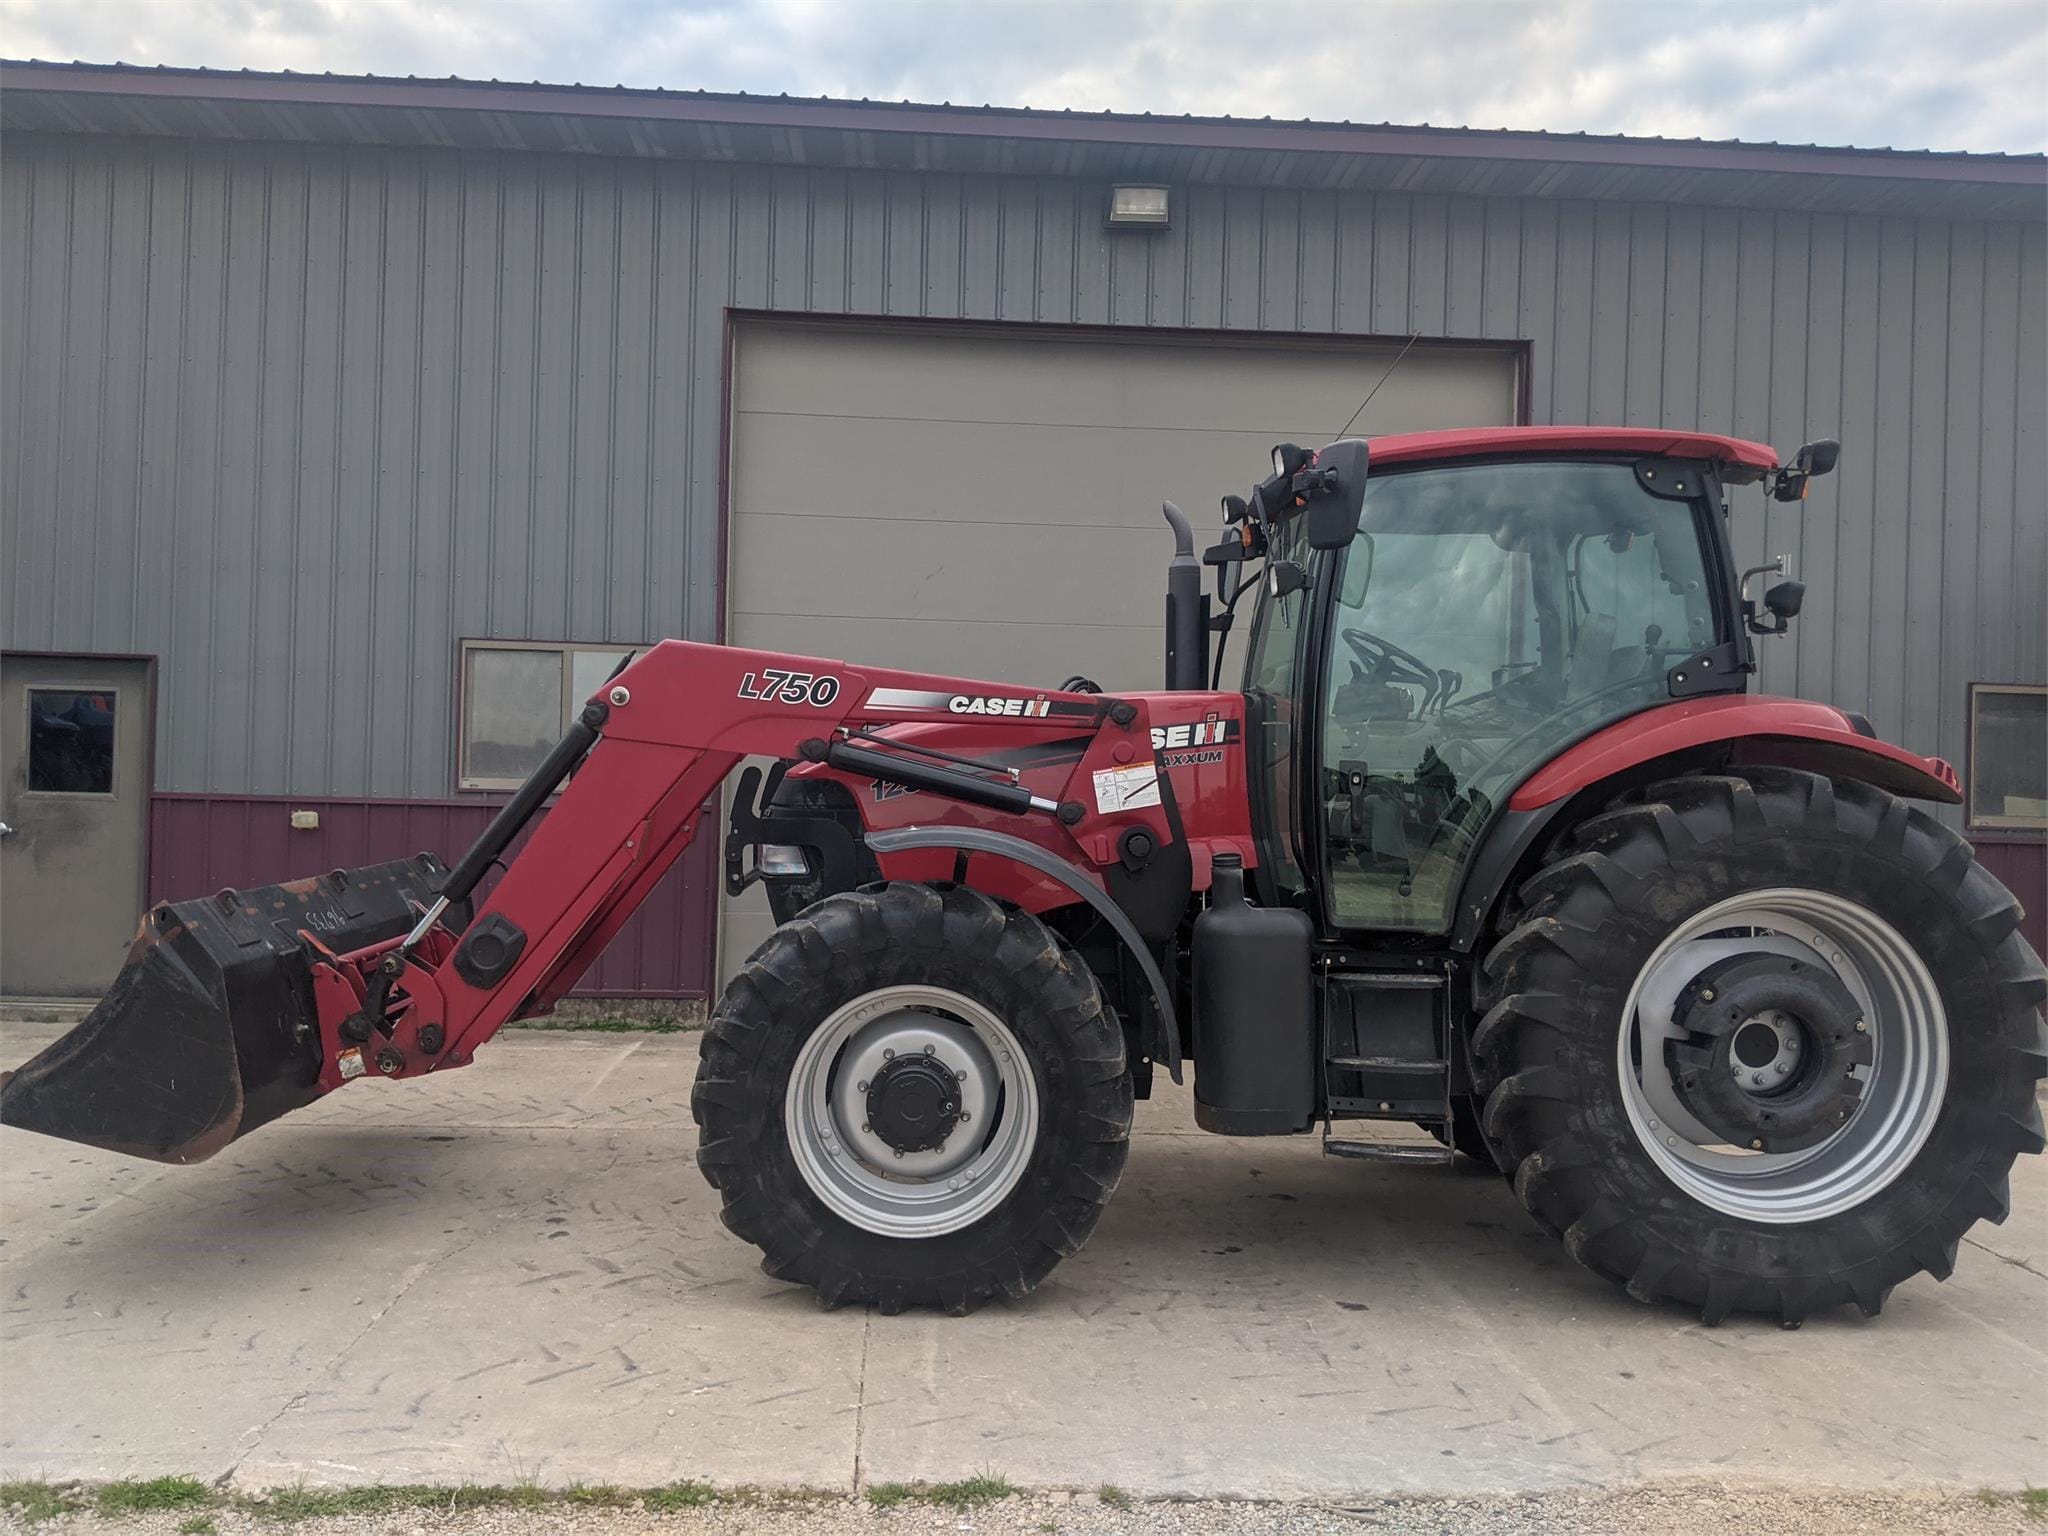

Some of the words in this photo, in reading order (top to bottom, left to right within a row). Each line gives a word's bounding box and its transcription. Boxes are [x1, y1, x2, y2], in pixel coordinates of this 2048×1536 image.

[737, 668, 840, 707] L750
[948, 695, 1024, 716] CASE
[1150, 725, 1191, 750] SE
[1162, 749, 1224, 768] AXXUM
